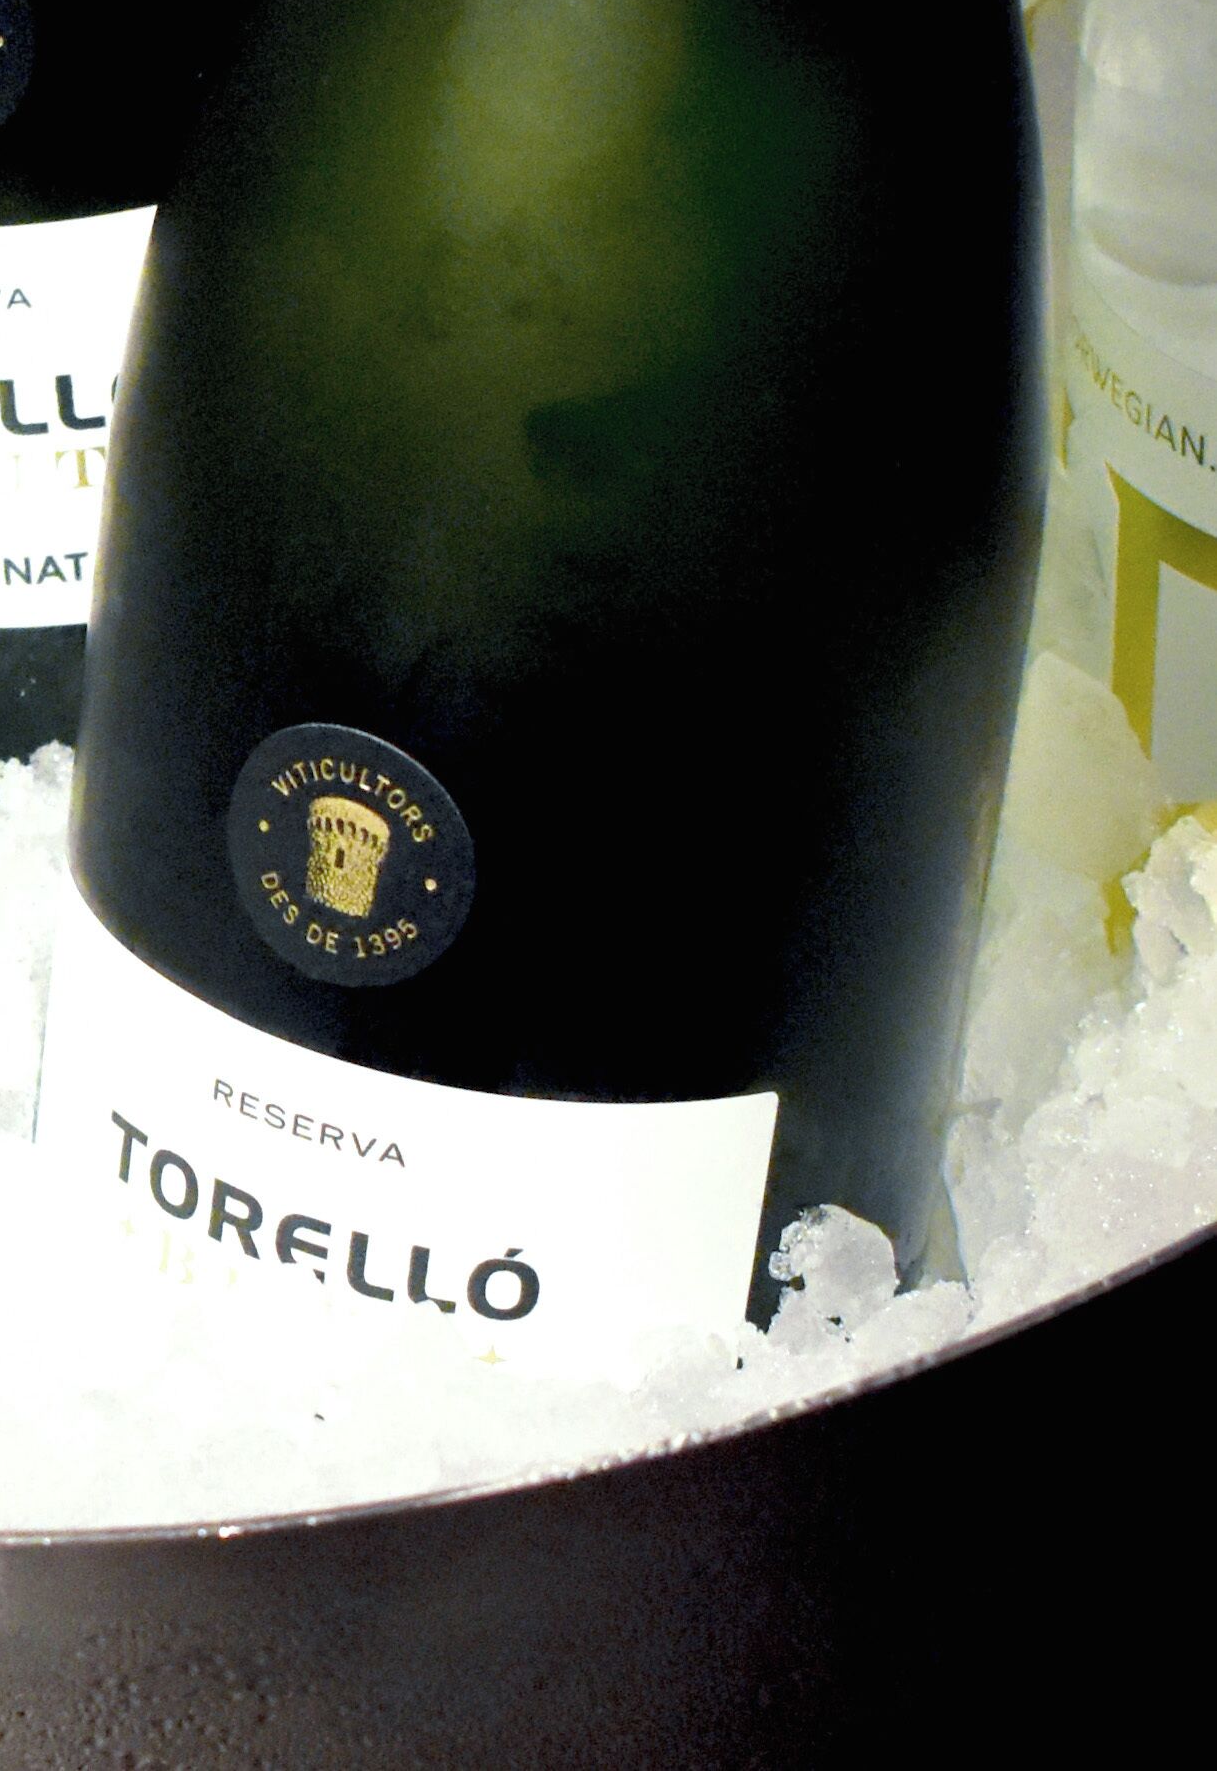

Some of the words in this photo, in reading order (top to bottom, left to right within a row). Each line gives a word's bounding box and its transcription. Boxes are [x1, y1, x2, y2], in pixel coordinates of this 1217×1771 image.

[271, 757, 435, 845] VITICULTORS
[259, 870, 301, 926] DES
[305, 922, 340, 956] DE
[354, 915, 420, 959] 1395
[212, 1077, 408, 1169] RESERVA
[109, 1109, 541, 1323] TORELLÓ
